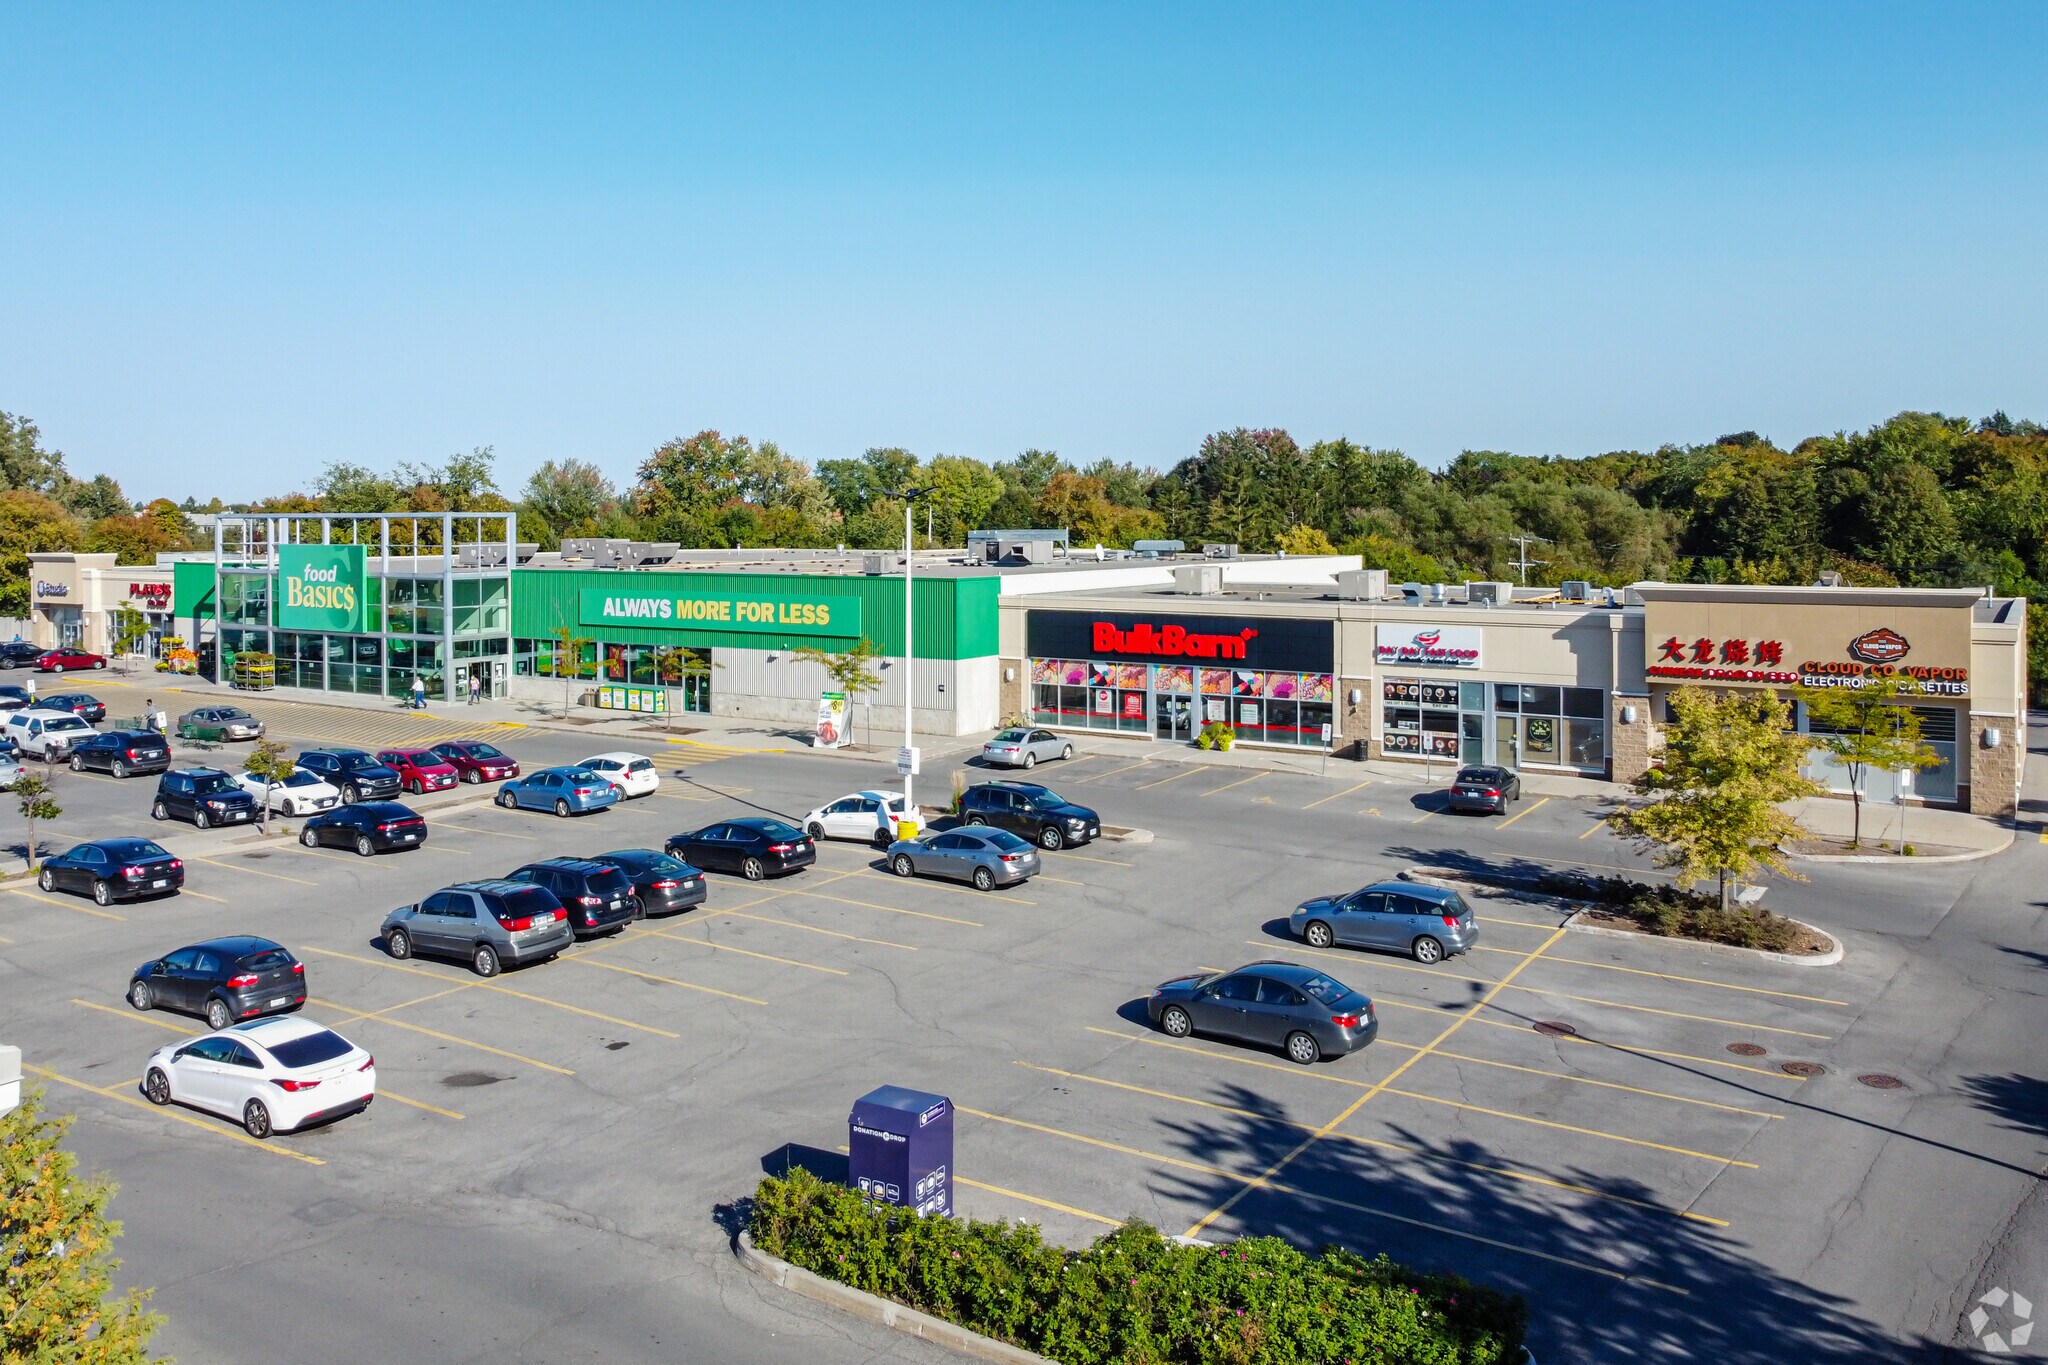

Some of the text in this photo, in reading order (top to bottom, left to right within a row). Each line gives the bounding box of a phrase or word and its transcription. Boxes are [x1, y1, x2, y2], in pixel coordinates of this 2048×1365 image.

[304, 563, 337, 582] food
[603, 597, 830, 625] ALWAYS MORE FOR LESS
[1379, 646, 1478, 658] DAY DAY FAST FOOD
[1650, 666, 1799, 683] CHINESE DRAGON BBQ
[1804, 660, 1864, 675] CLOUD
[1906, 665, 1968, 680] VAPOR
[853, 1125, 906, 1143] DONATION DROP
